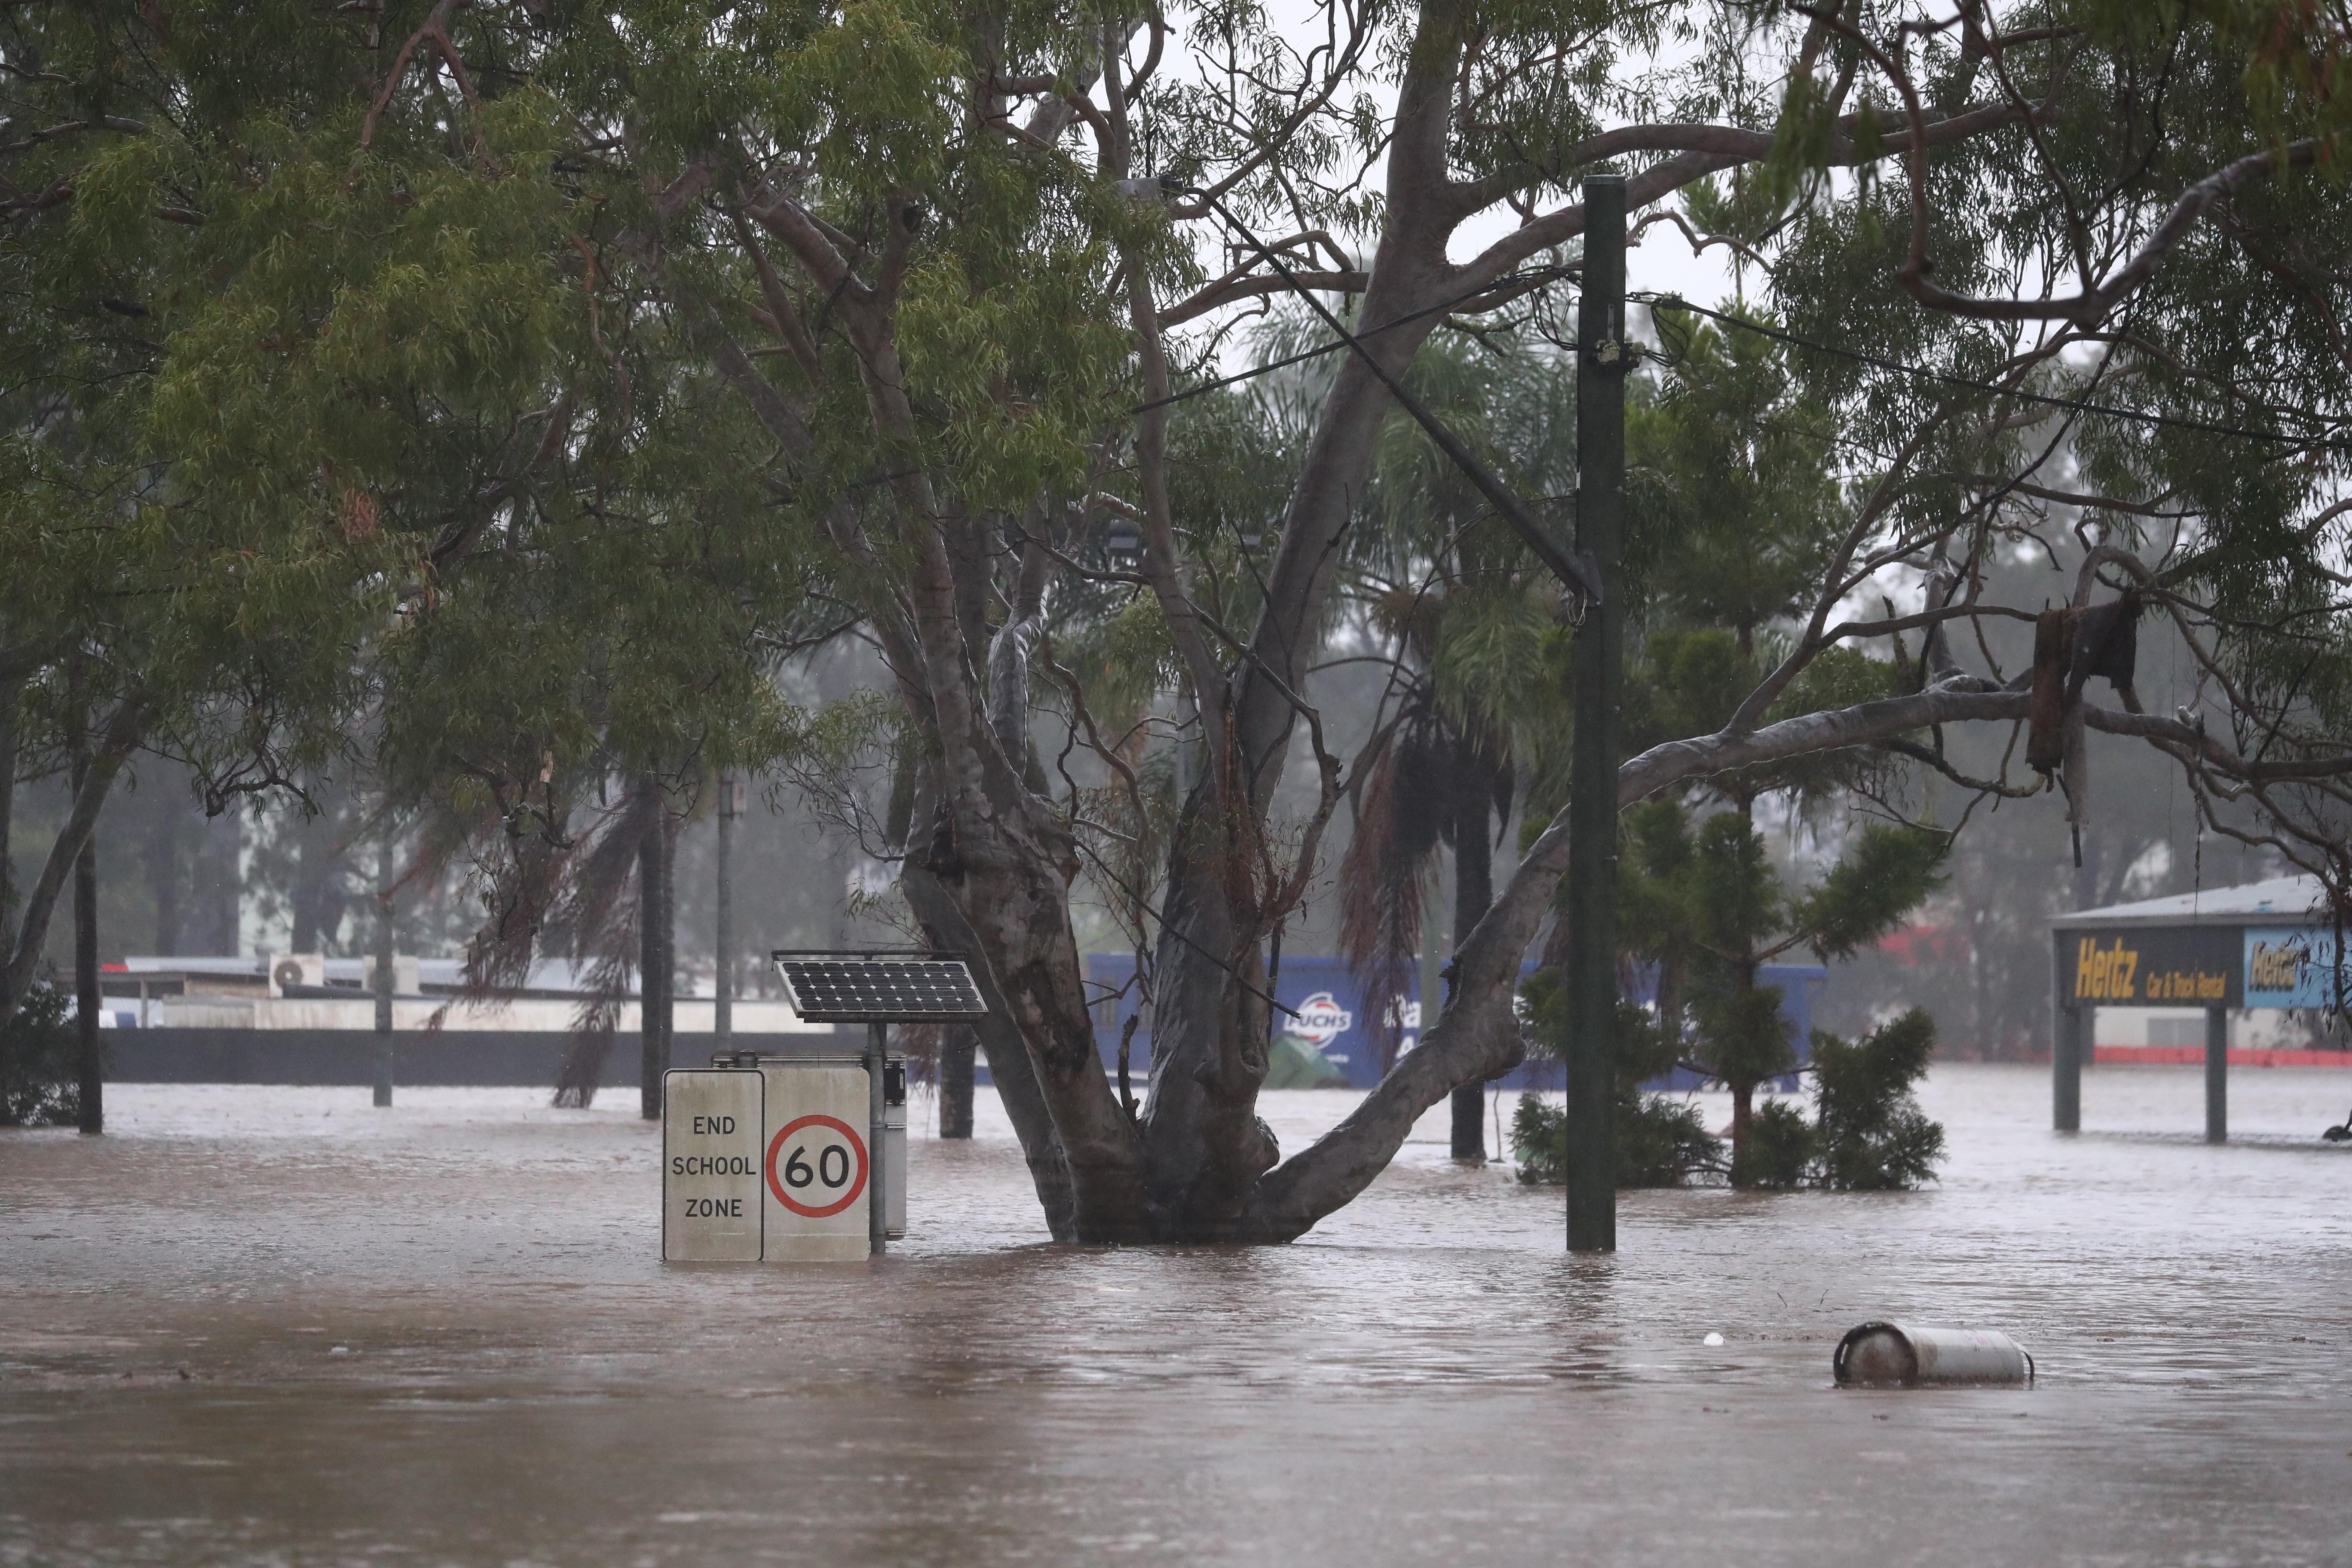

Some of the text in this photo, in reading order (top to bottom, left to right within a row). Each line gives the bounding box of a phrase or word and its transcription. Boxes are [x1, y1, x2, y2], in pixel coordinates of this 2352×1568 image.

[2075, 937, 2138, 998] Hertz
[693, 1116, 735, 1135] END
[672, 1157, 756, 1176] SCHOOL
[785, 1145, 849, 1188] 60
[685, 1199, 743, 1217] ZONE
